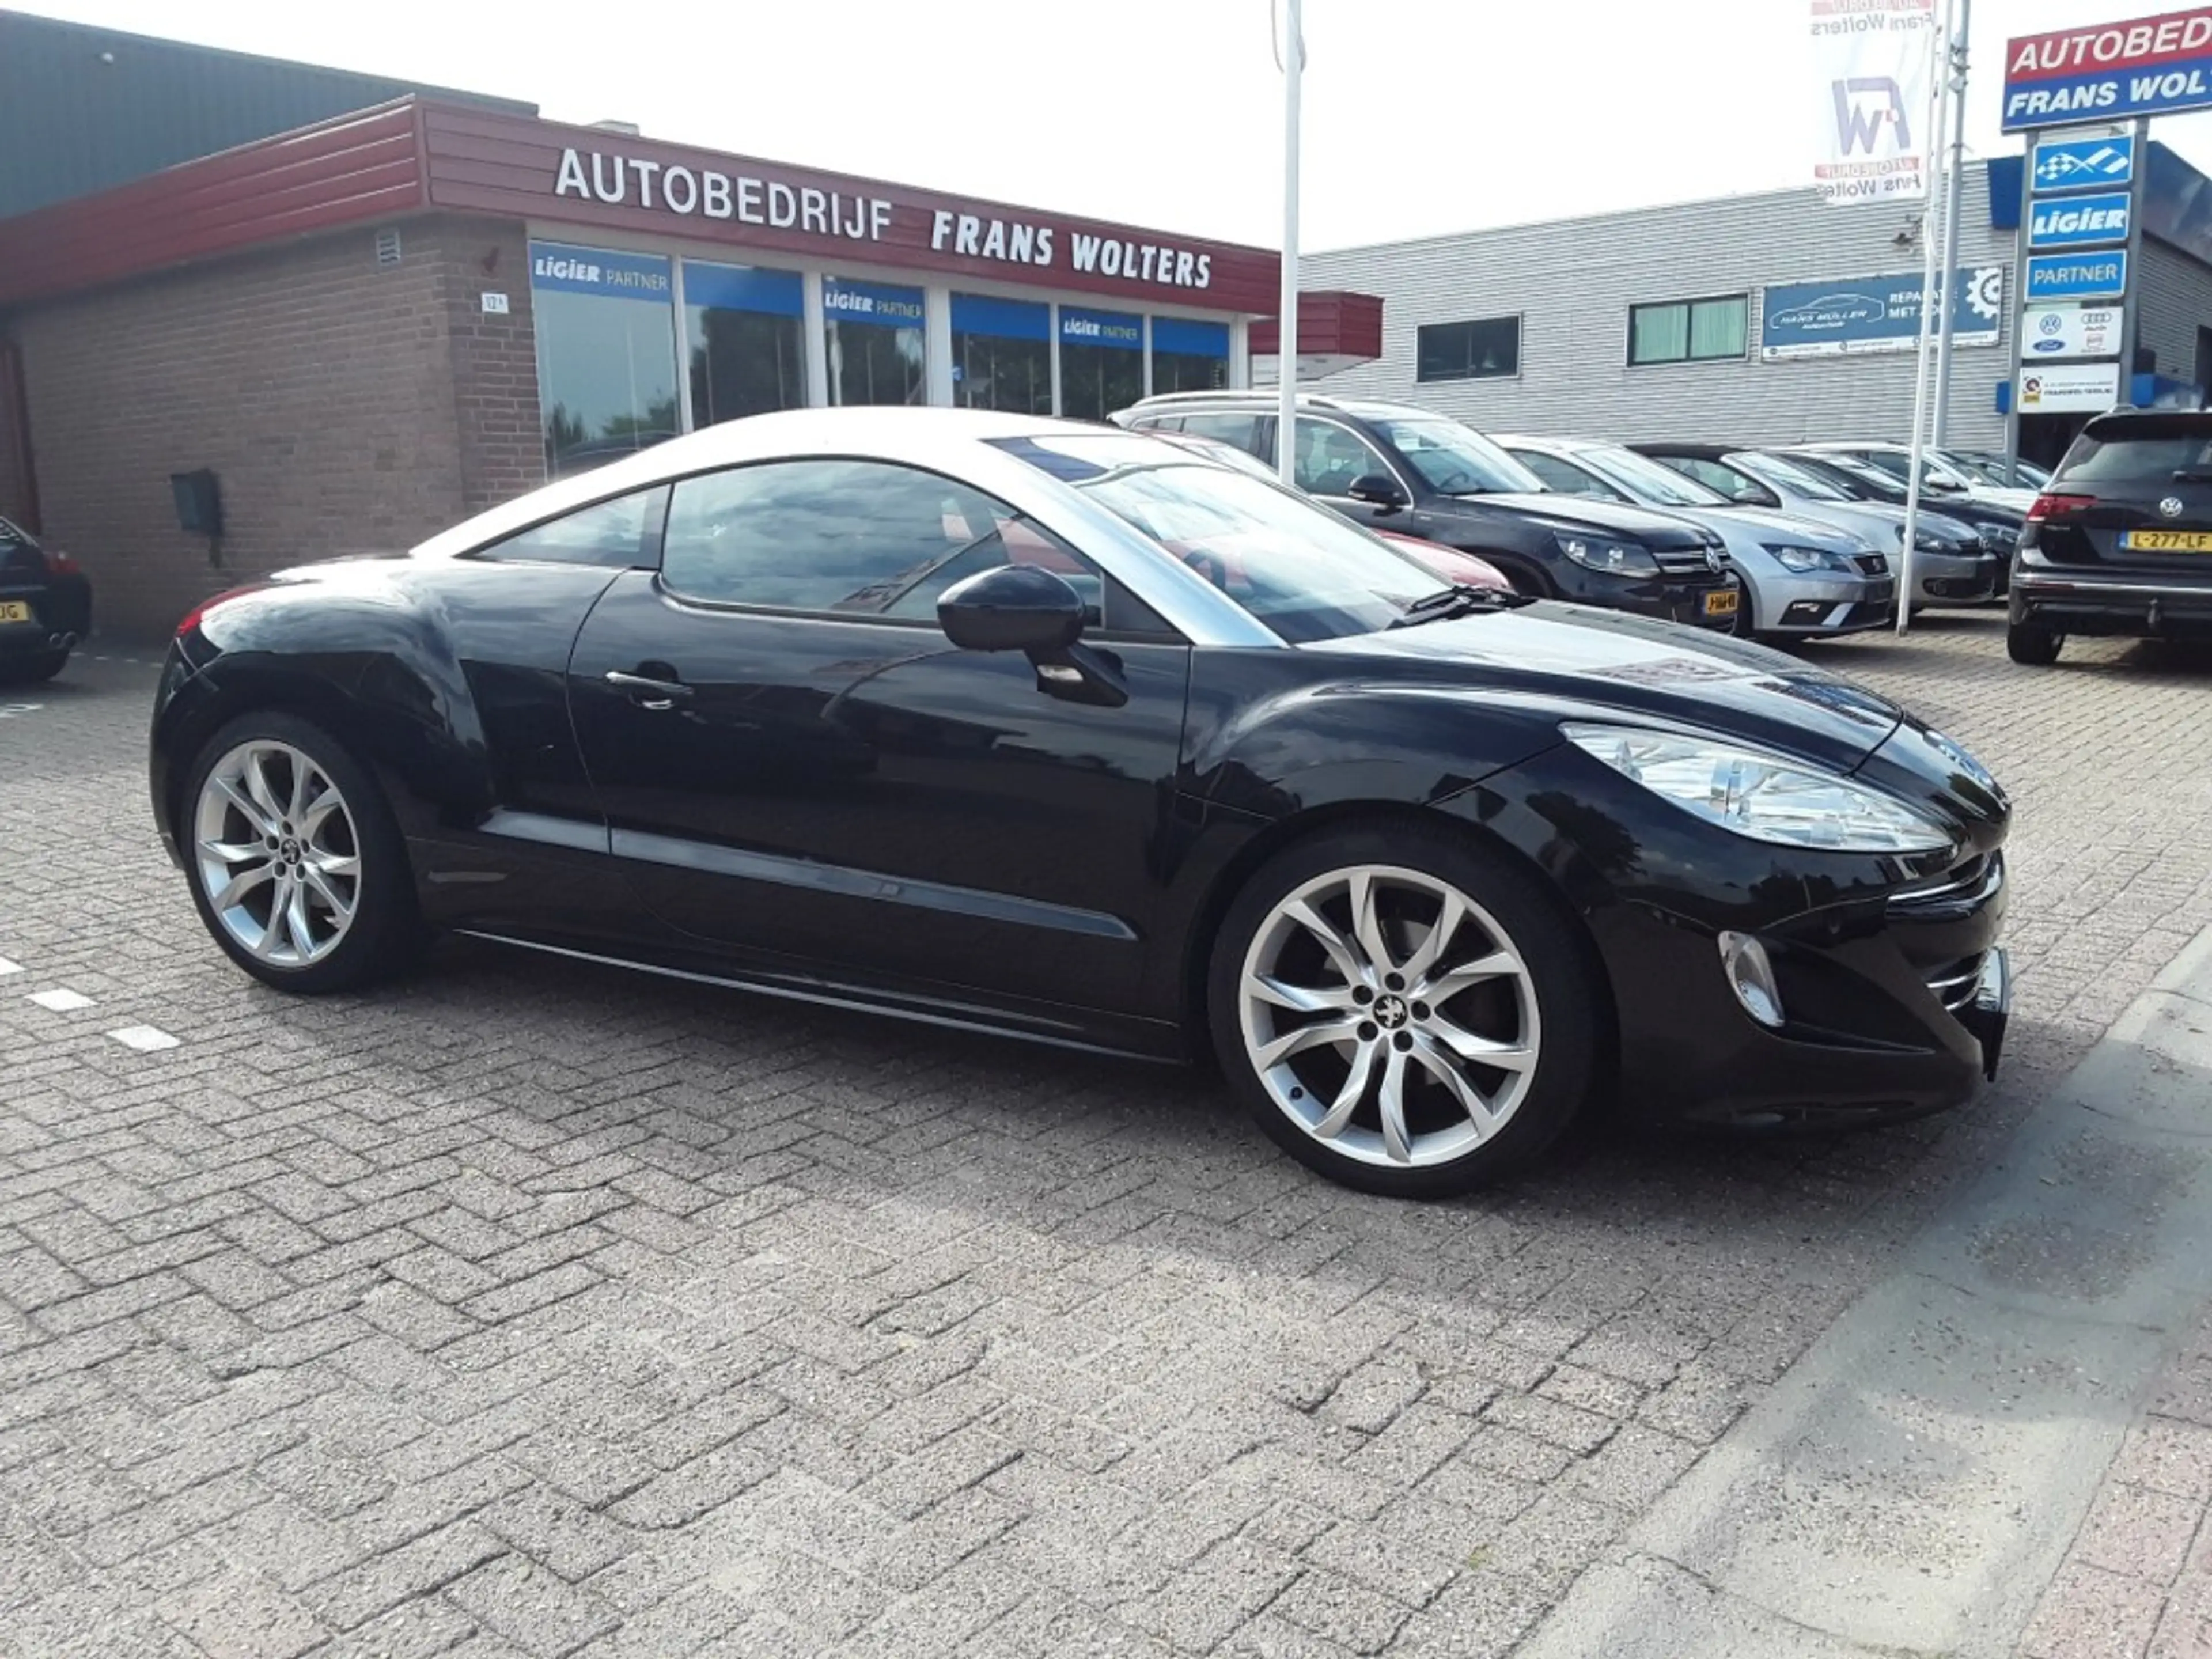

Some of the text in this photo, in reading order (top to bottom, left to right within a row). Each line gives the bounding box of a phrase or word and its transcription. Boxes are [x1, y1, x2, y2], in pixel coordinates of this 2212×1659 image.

[2011, 16, 2212, 73] AUTOBED
[2007, 68, 2212, 118] FRANS WOL
[555, 148, 1211, 288] AUTOBEDRIJF FRANS WOLTERS
[606, 269, 670, 291] PARTNER
[2033, 263, 2119, 285] PARTNER
[1888, 306, 1917, 319] MET
[2134, 533, 2208, 548] L-277-LF
